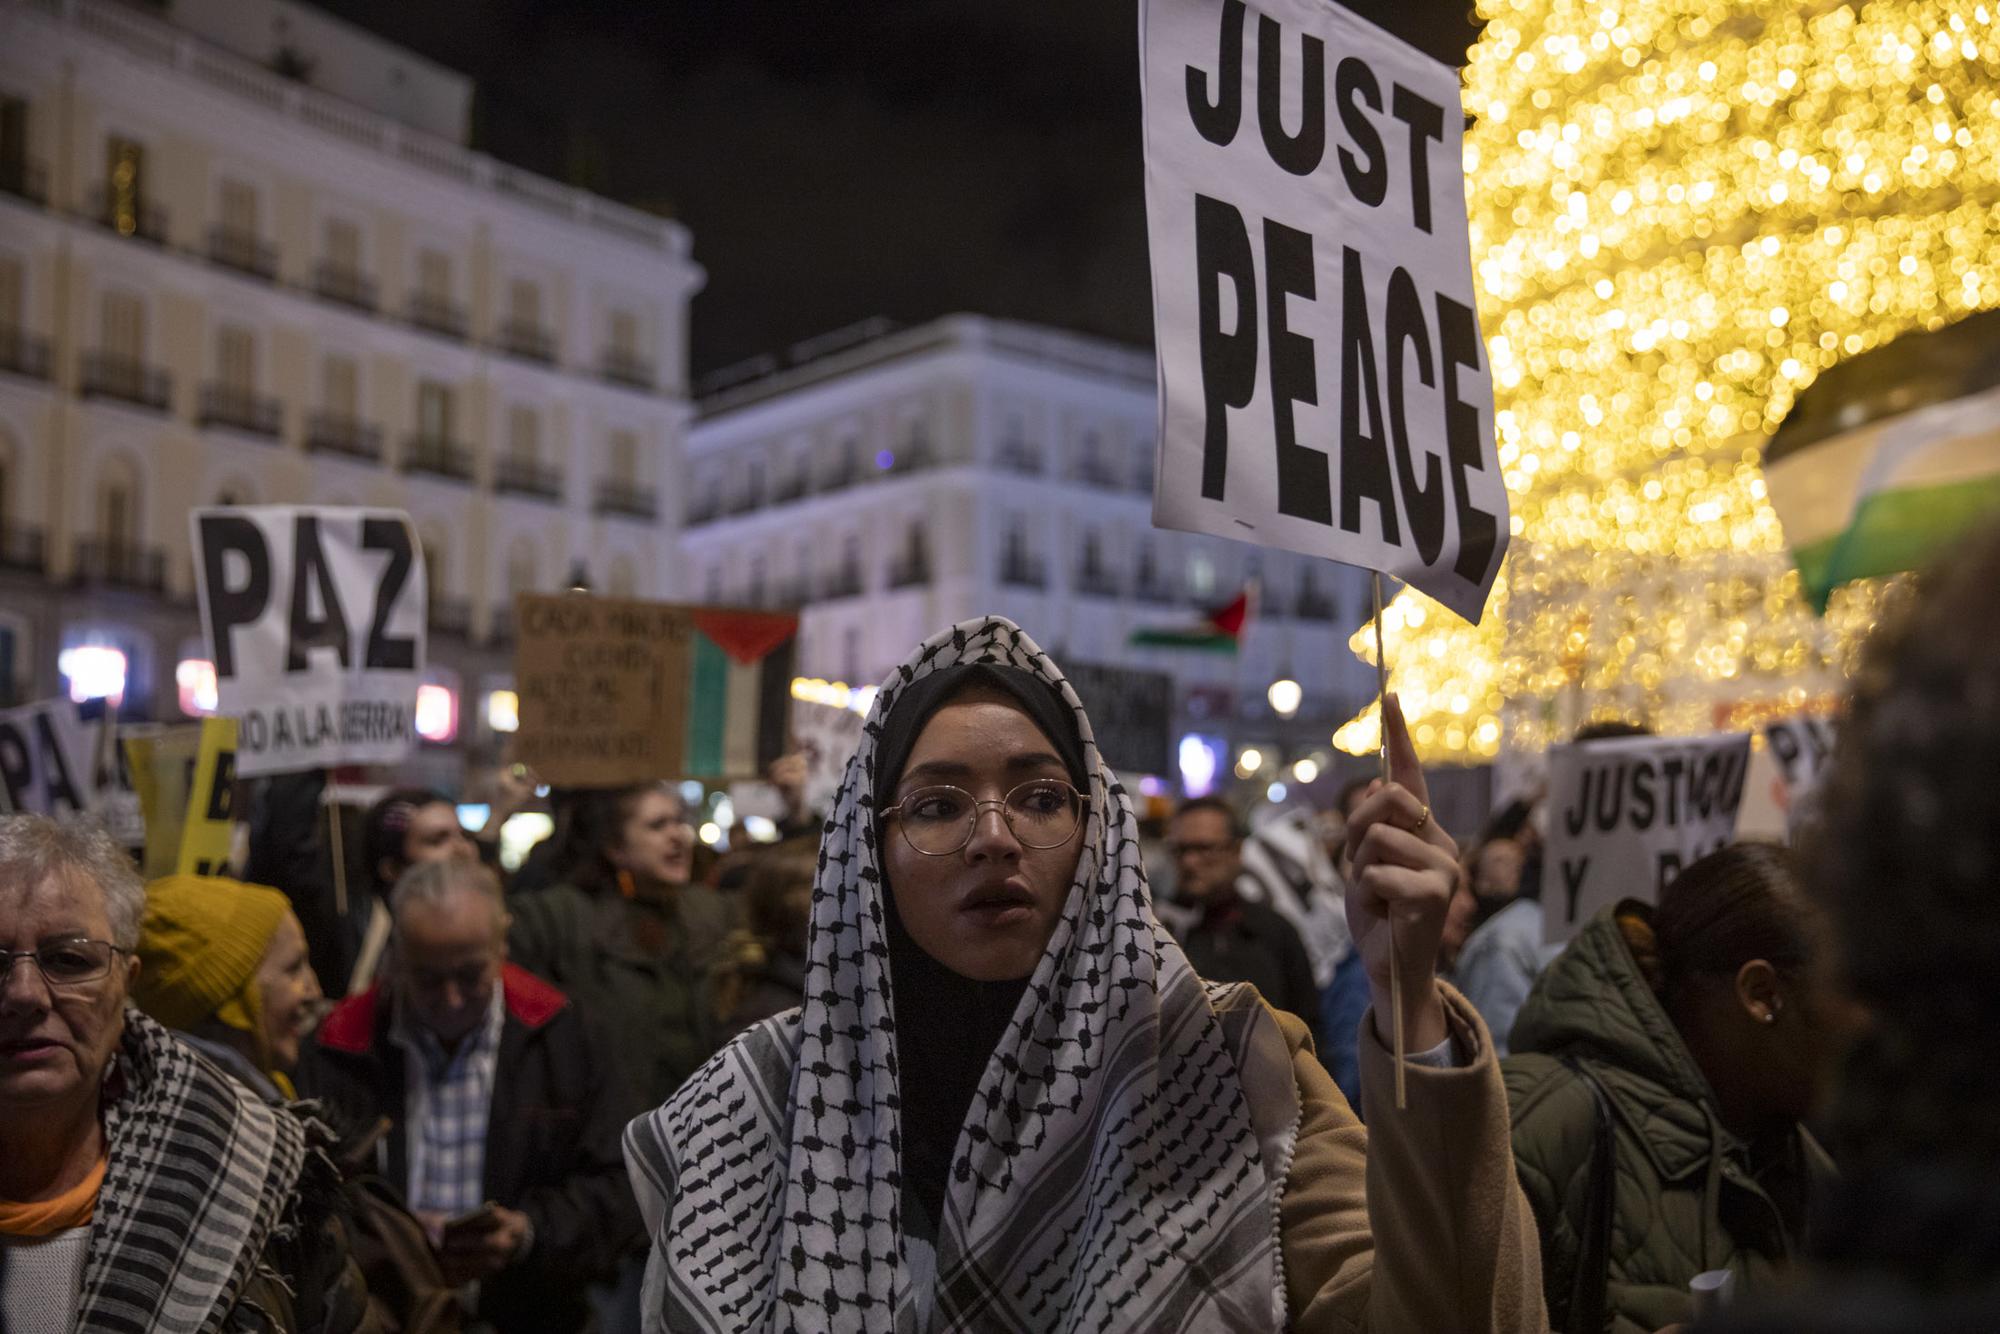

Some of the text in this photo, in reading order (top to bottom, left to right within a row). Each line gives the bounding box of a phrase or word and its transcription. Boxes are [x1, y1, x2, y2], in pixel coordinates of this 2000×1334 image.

[1185, 0, 1445, 234] JUST
[1195, 192, 1497, 587] PEACE
[199, 516, 416, 677] PAZ
[271, 706, 297, 749] A
[296, 702, 338, 748] LA
[1560, 856, 1589, 924] Y
